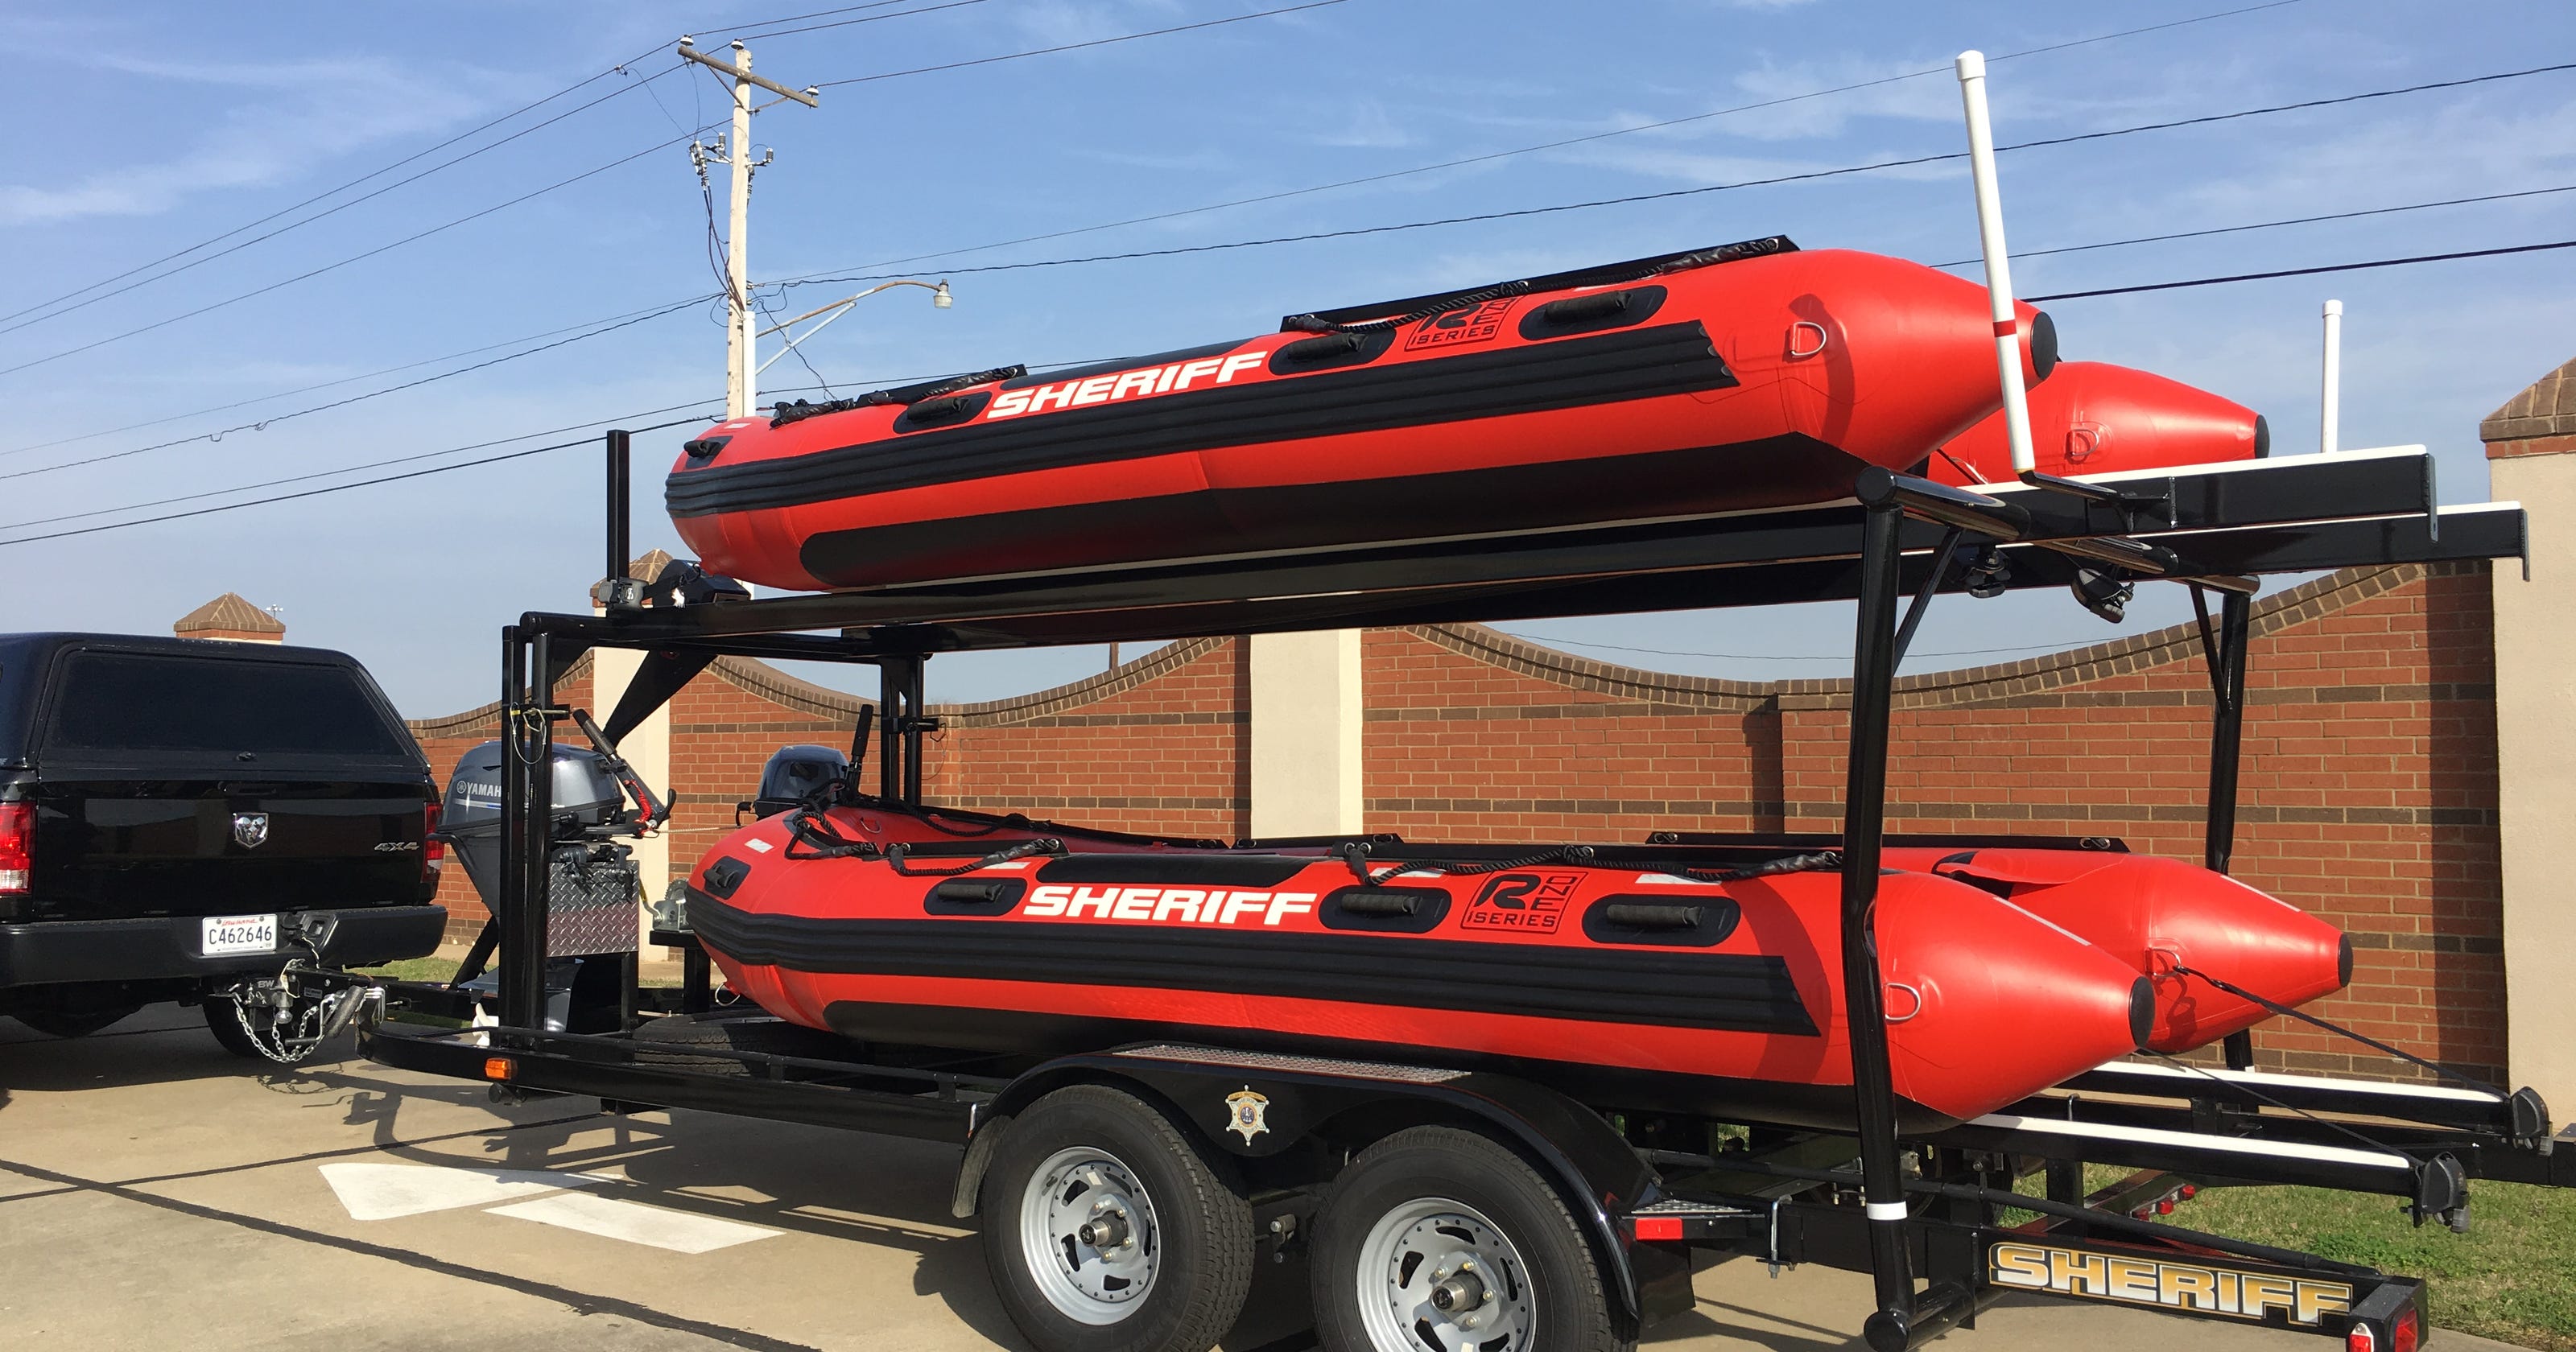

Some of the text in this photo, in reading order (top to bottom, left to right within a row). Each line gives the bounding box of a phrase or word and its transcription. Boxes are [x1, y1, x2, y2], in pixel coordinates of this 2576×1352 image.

[987, 351, 1268, 419] SHERIFF
[467, 781, 502, 797] YAMAH
[1023, 885, 1318, 925] SHERIFF
[209, 925, 272, 945] C462646
[1989, 1242, 2352, 1326] SHERIFF
